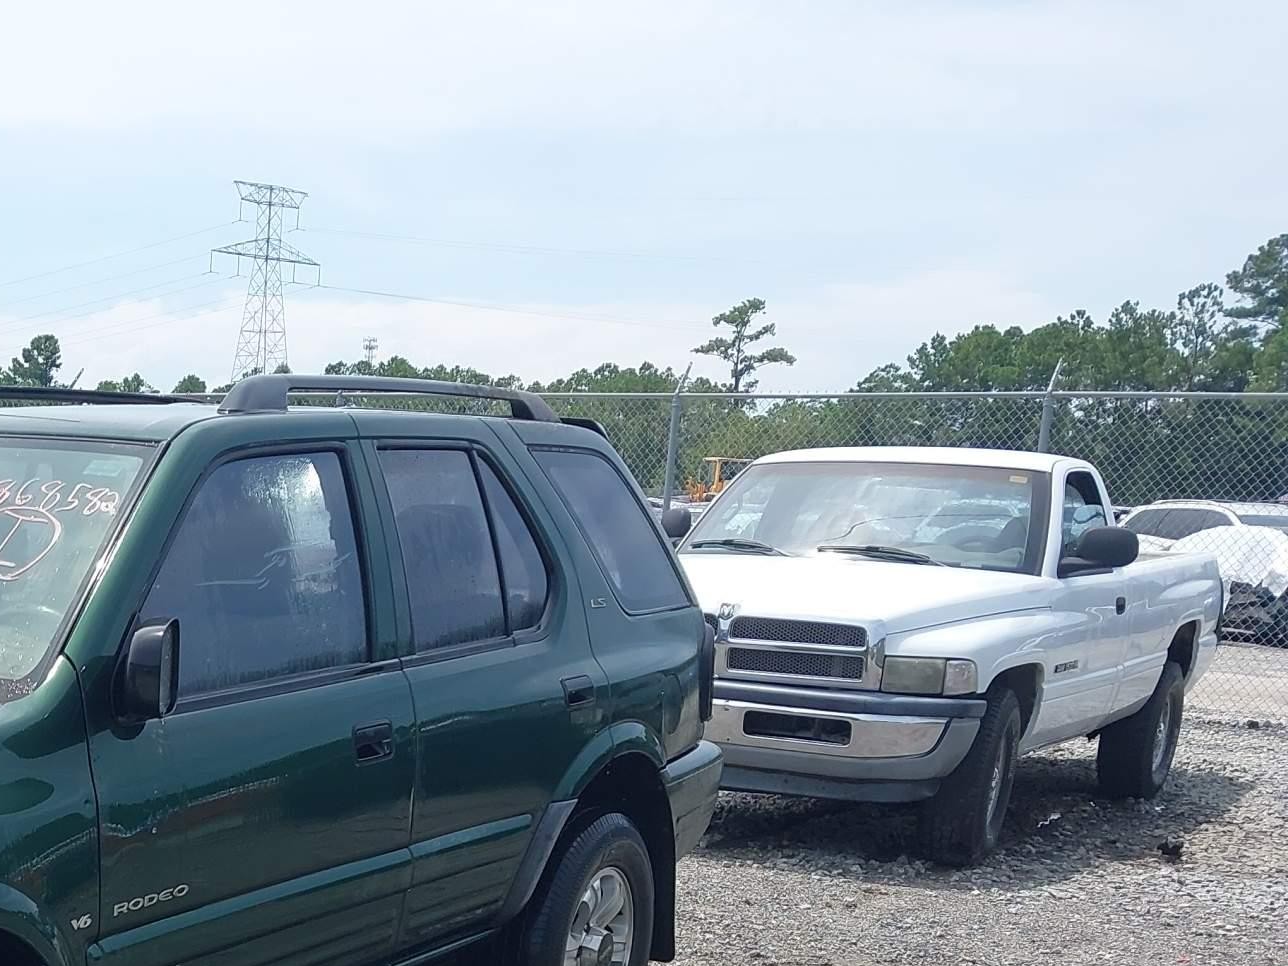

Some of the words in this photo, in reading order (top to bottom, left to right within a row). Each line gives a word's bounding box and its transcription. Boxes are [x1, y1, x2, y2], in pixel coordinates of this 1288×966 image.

[590, 597, 607, 608] LS
[112, 884, 190, 917] RODEO
[70, 913, 92, 931] V6
